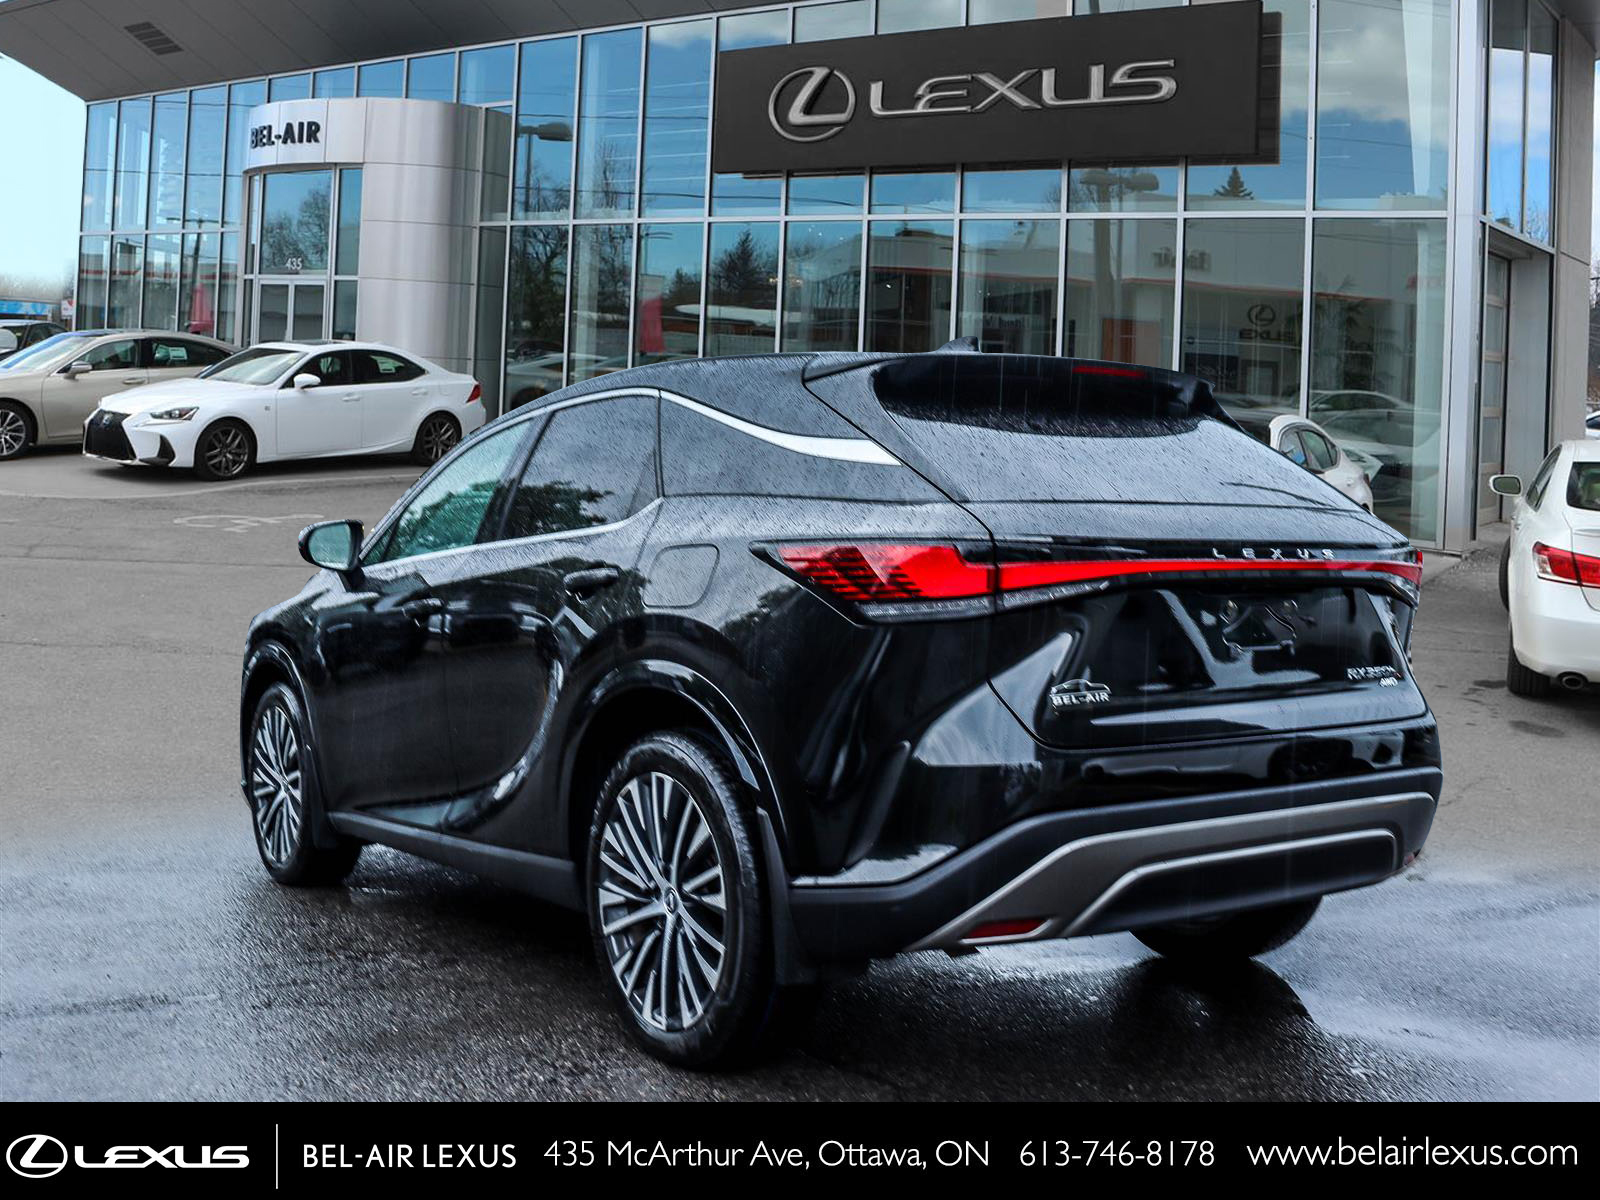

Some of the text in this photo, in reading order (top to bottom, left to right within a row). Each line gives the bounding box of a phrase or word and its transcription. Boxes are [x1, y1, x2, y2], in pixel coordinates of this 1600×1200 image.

[869, 59, 1177, 117] LEXUS
[250, 121, 321, 149] BEL-AIR
[285, 258, 302, 270] 435
[1212, 548, 1336, 561] LEXUS
[1051, 692, 1110, 707] BEL-AIR
